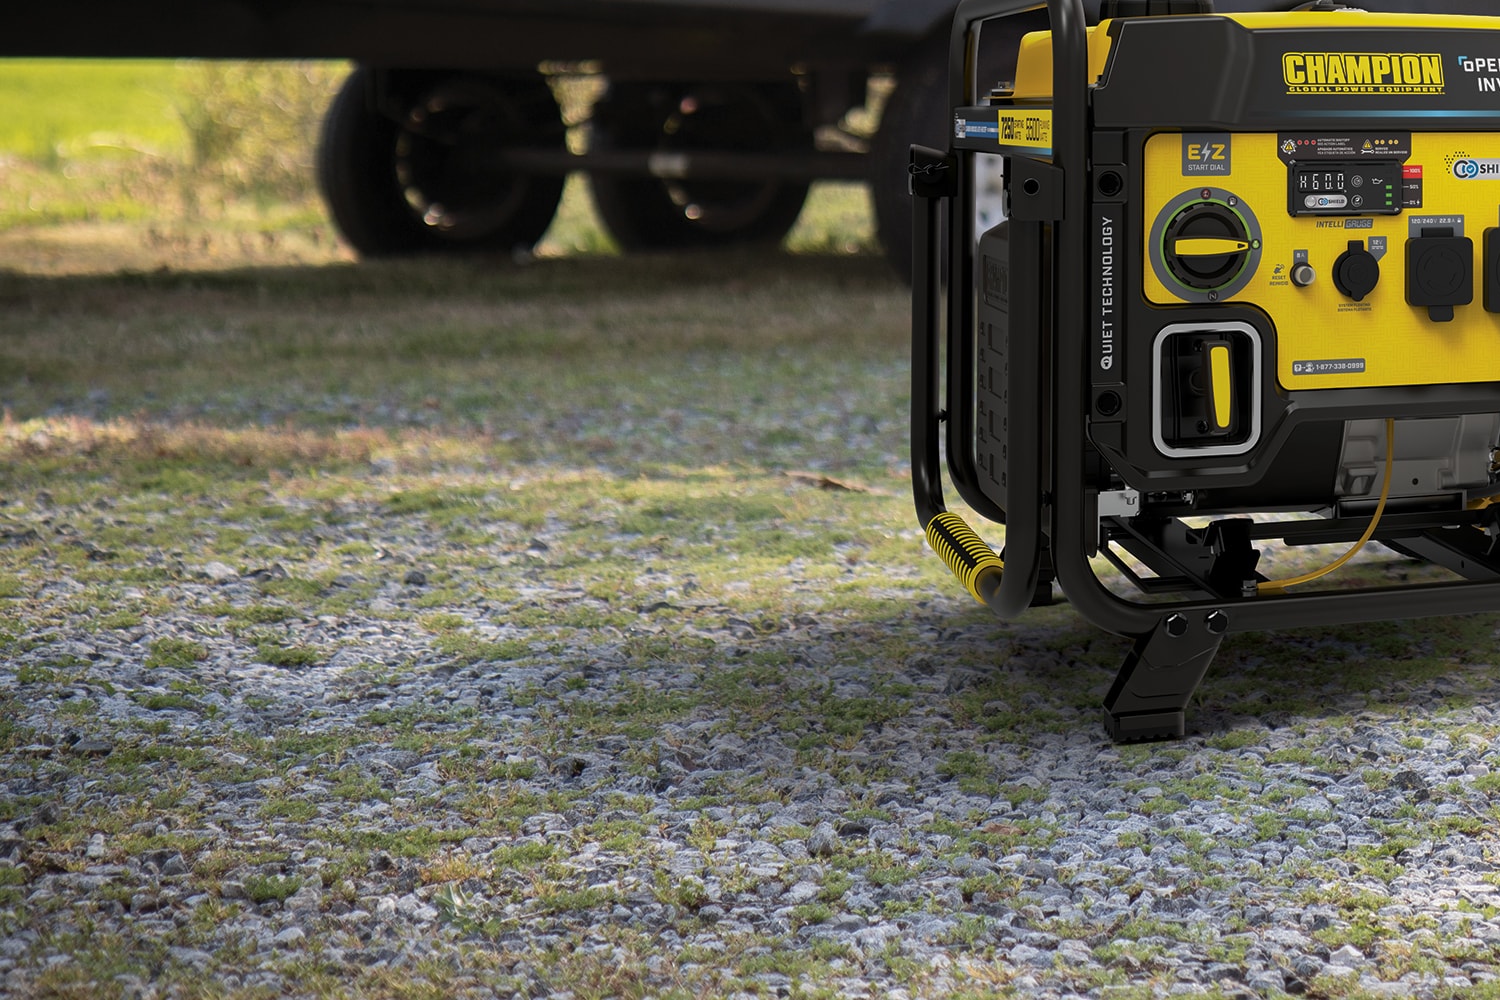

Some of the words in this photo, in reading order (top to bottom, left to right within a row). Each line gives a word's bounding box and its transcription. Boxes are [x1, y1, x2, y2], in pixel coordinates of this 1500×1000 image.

[1283, 53, 1443, 85] CHAMPION
[1102, 216, 1113, 316] TECHNOLOGY
[1100, 321, 1113, 370] QUIET
